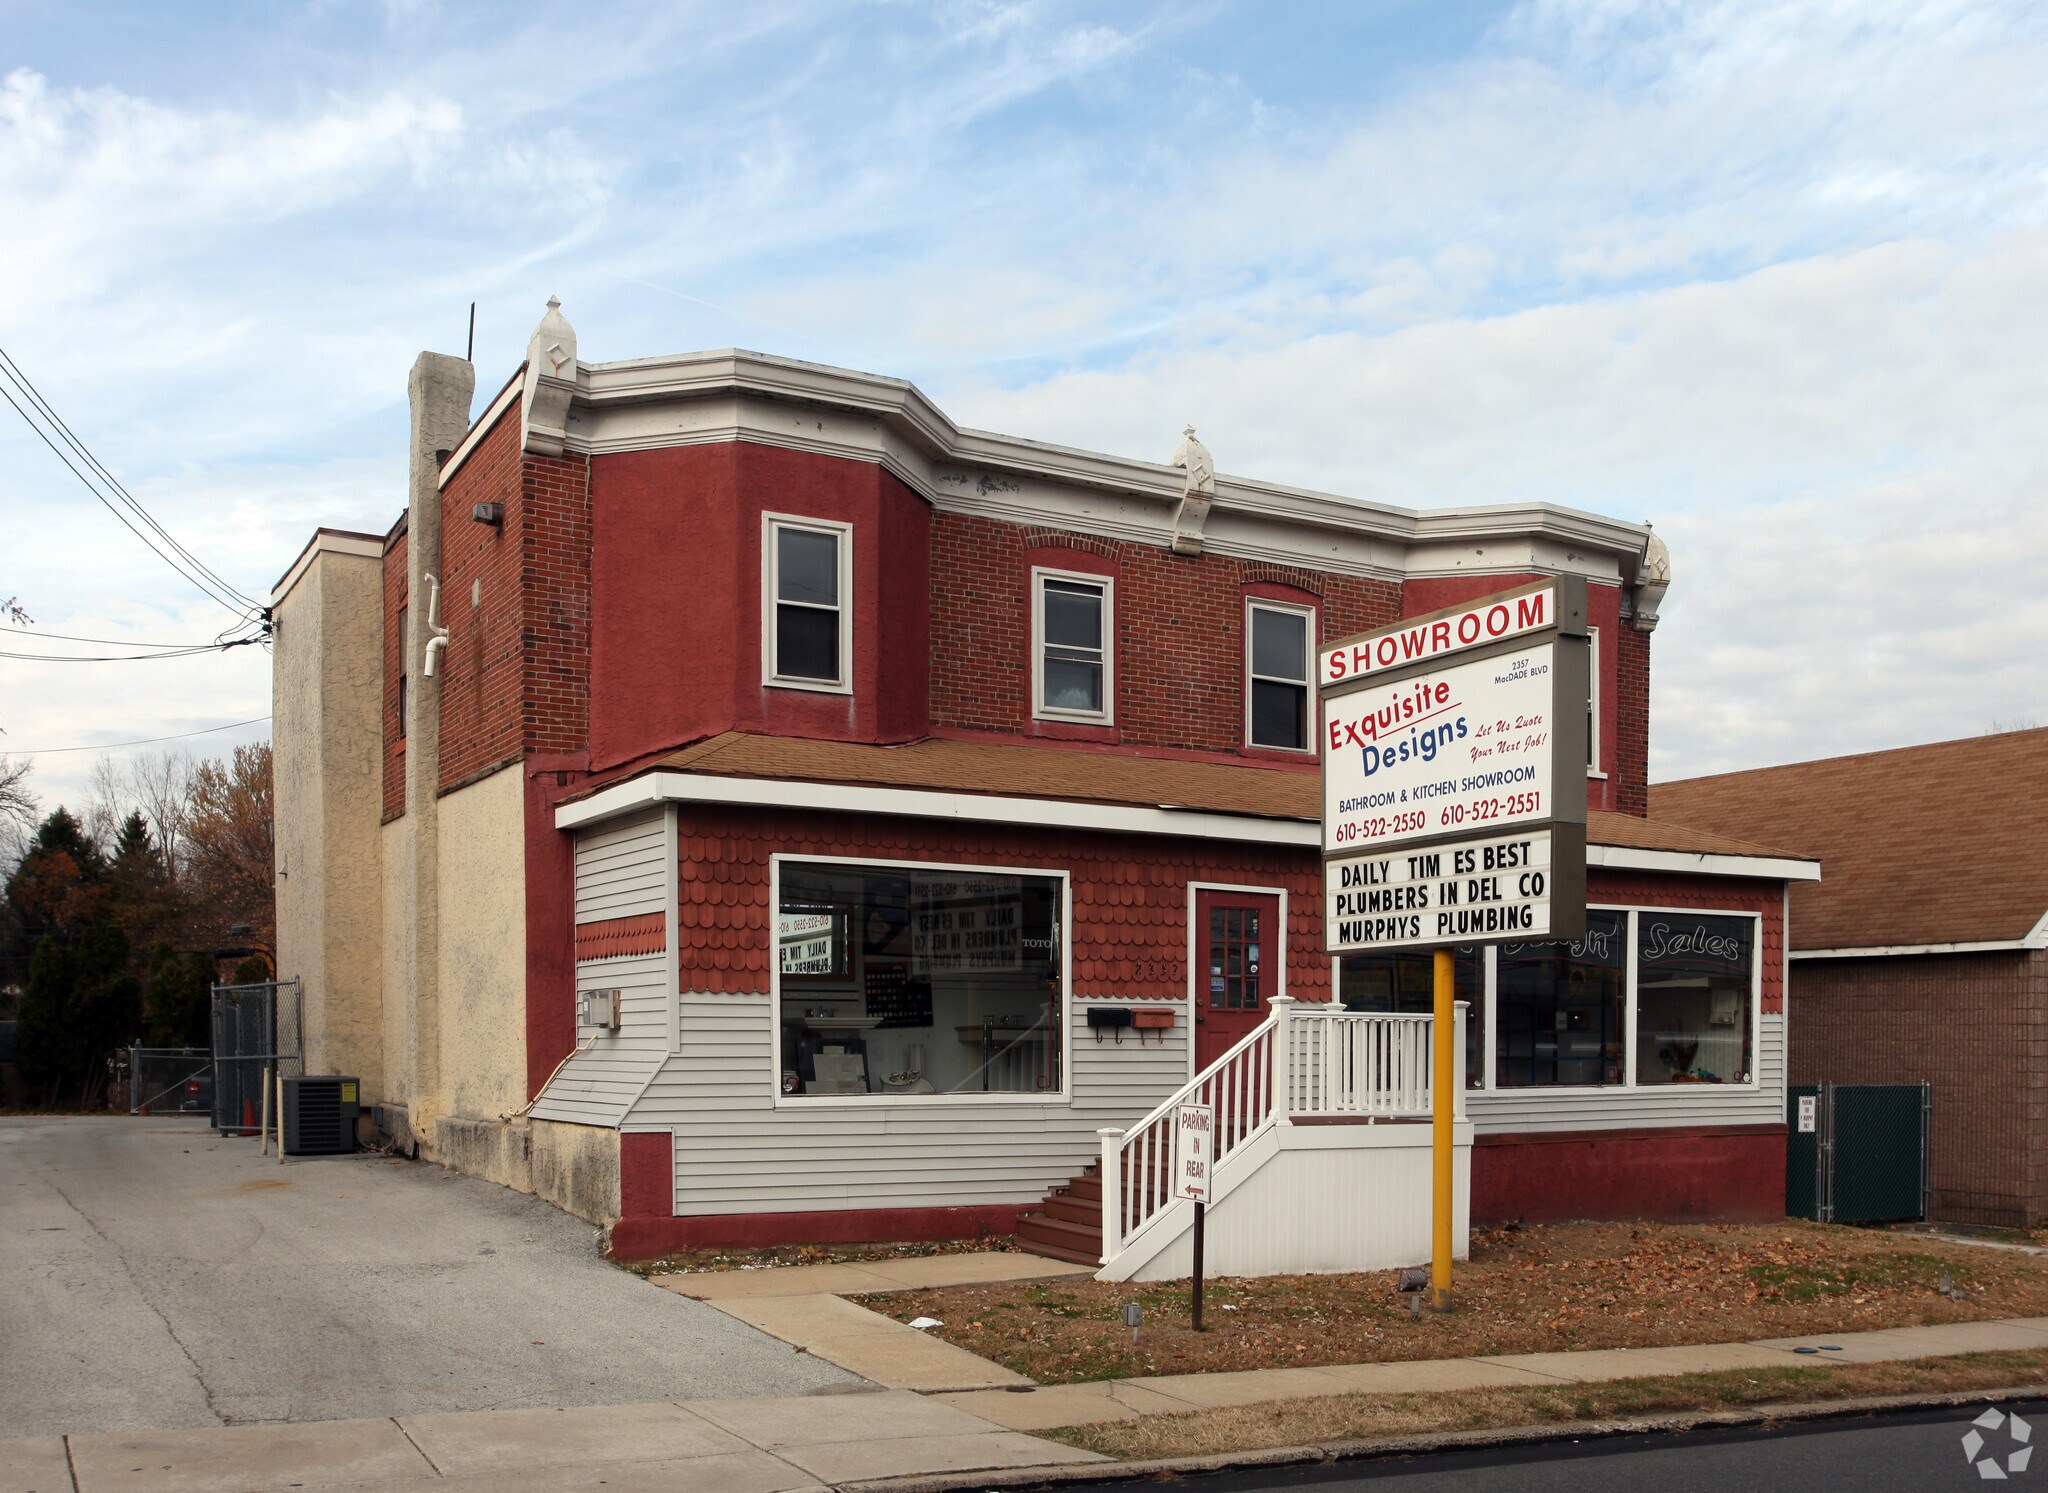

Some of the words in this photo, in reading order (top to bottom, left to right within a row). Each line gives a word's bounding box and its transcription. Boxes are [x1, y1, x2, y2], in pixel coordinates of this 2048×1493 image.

[1329, 593, 1543, 679] SHOWROOM
[1494, 669, 1528, 684] MacDADE
[1530, 665, 1548, 676] BLVD
[1512, 659, 1529, 671] 2357
[1329, 681, 1450, 750] Exquisite
[1475, 724, 1492, 738] Let
[1496, 720, 1510, 733] Us
[1514, 715, 1543, 729] Quote
[1362, 716, 1468, 777] Designs
[1470, 746, 1493, 764] Your
[1496, 740, 1521, 754] Next
[1523, 732, 1547, 753] Job!
[1339, 791, 1396, 813] BATHROOM
[1400, 789, 1408, 802] &
[1413, 780, 1457, 801] KITCHEN
[1461, 765, 1536, 792] SHOWROOM
[1336, 810, 1426, 843] 610-522-2550
[1440, 791, 1541, 826] 610-522-2551
[1341, 860, 1390, 888] DAILY
[1484, 841, 1531, 871] BEST
[1336, 885, 1428, 916] PLUMBERS
[1439, 881, 1458, 906] IN
[1468, 876, 1502, 903] DEL
[1519, 872, 1545, 897] CO
[1339, 915, 1421, 943] MURPHYS
[1438, 904, 1533, 936] PLUMBING
[1644, 922, 1738, 960] Sales
[1022, 939, 1051, 948] TOTO
[1135, 963, 1179, 976] 2357
[1182, 1112, 1209, 1132] PARKING
[1193, 1137, 1200, 1154] IN
[1186, 1160, 1205, 1179] REAR
